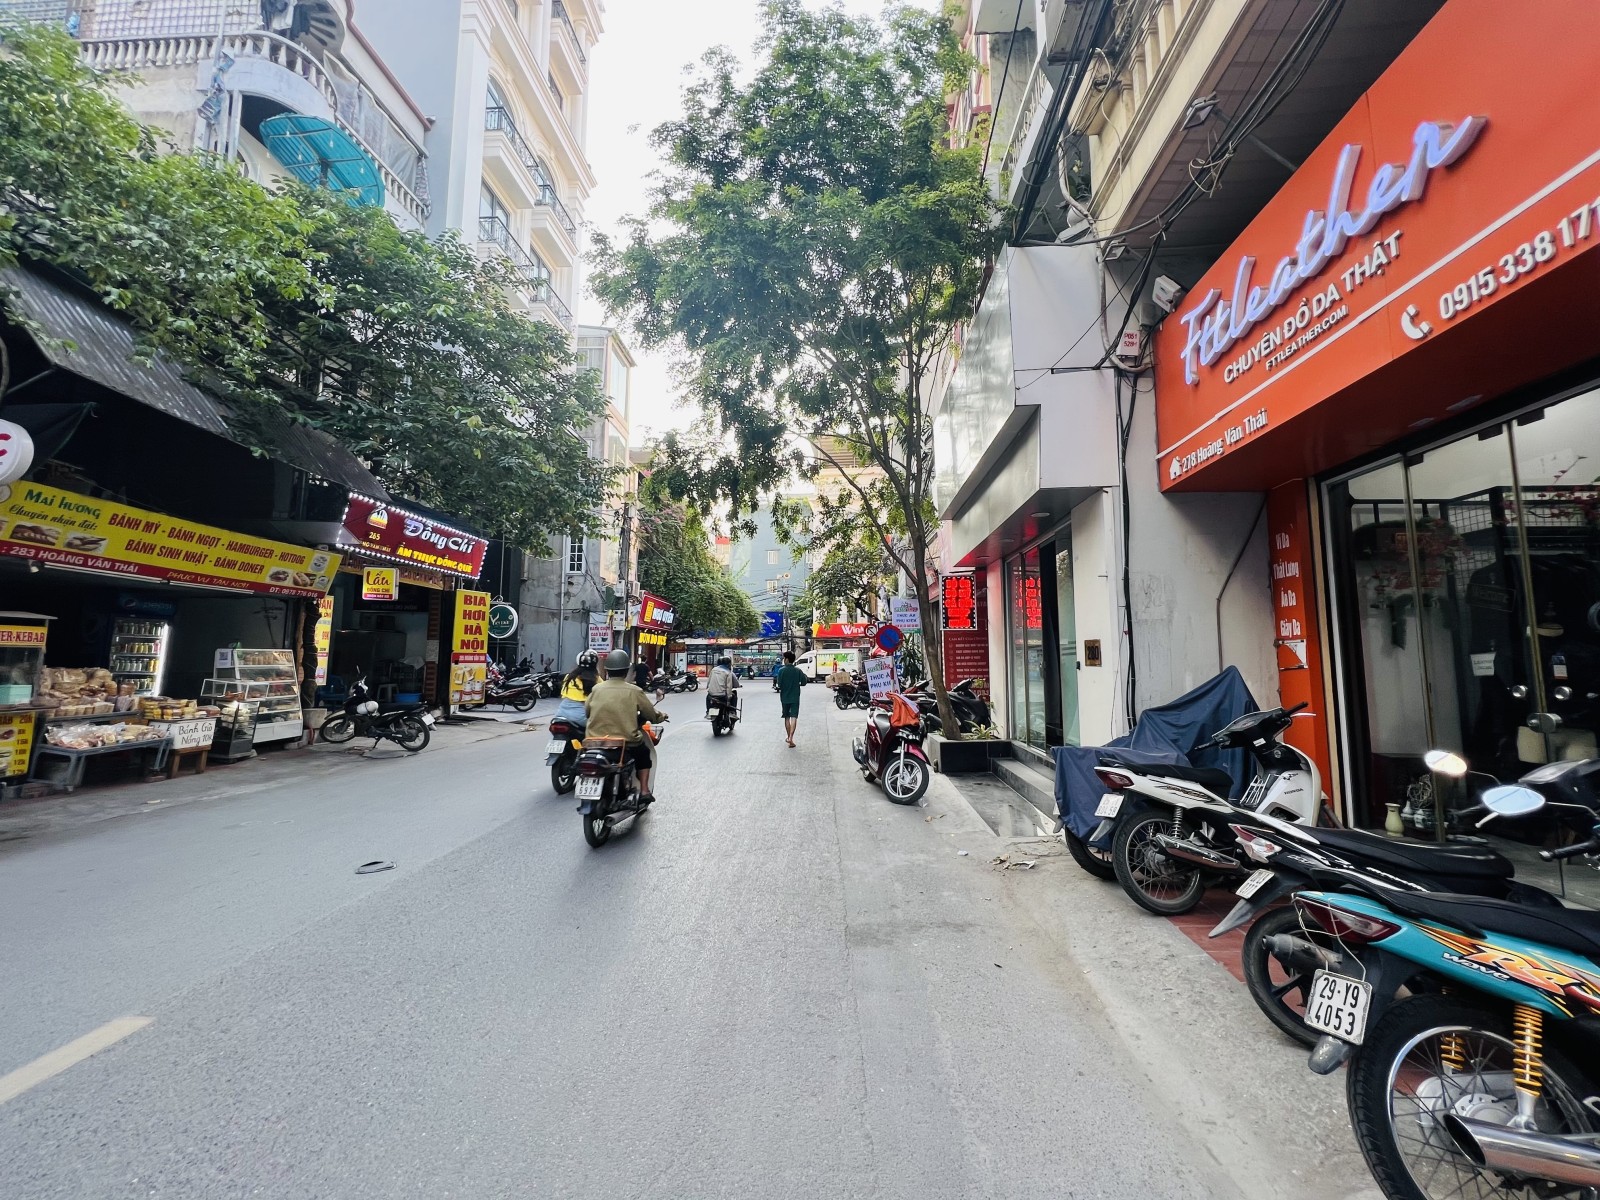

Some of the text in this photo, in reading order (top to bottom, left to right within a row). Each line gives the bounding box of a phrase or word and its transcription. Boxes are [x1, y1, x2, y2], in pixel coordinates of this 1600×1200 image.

[1439, 265, 1498, 321] 0915
[1499, 230, 1557, 285] 338
[1223, 230, 1404, 384] CHUYÊN ĐỒ DA THẬT
[1266, 304, 1349, 371] FTTLEATHER.COM
[1182, 407, 1269, 473] 278 Hoàng Văn Thái
[108, 512, 142, 531] BÁNH
[167, 526, 195, 544] BÁNH
[195, 532, 222, 550] NGỌT
[226, 540, 275, 559] HAMBURGER
[278, 551, 306, 565] HOTDOG
[448, 537, 475, 553] Chí
[1282, 532, 1290, 548] Da
[10, 547, 139, 573] 283 HOÀNG VĂN THÁI
[125, 538, 265, 575] BÁNH SINH NHẬT BÁNH DONER
[463, 595, 486, 607] BIA
[1288, 589, 1297, 607] Da
[462, 609, 486, 621] HƠI
[1292, 619, 1301, 636] Da
[464, 623, 482, 635] HÀ
[460, 638, 485, 652] NỘI
[1319, 977, 1361, 1009] 29-Y9
[1314, 1004, 1356, 1036] 4053
